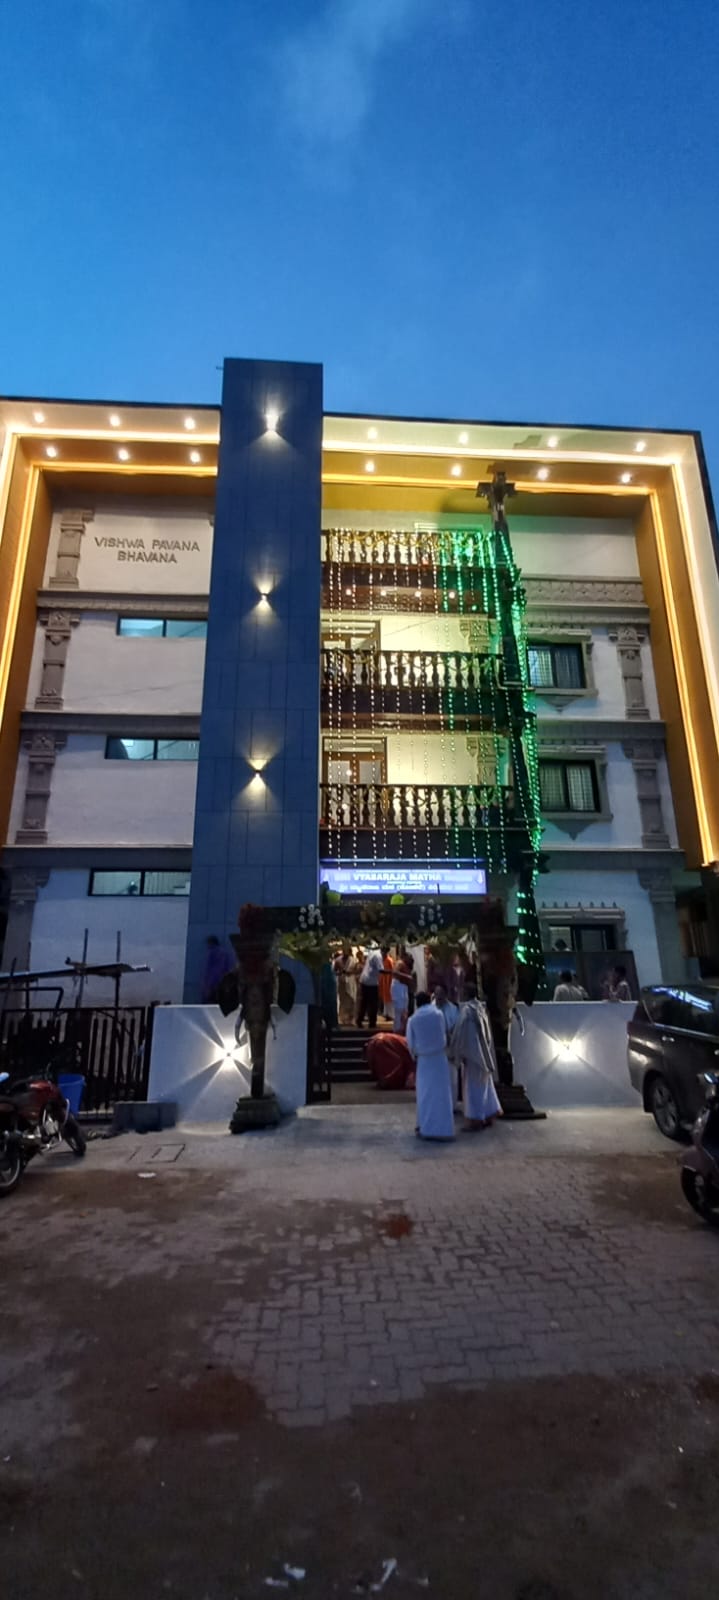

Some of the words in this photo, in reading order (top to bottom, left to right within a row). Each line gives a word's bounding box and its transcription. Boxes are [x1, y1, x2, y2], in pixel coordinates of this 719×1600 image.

[94, 537, 145, 549] VISHWA
[152, 539, 200, 552] PAVANA
[117, 550, 178, 564] BHAVANA
[409, 873, 442, 881] MATHA
